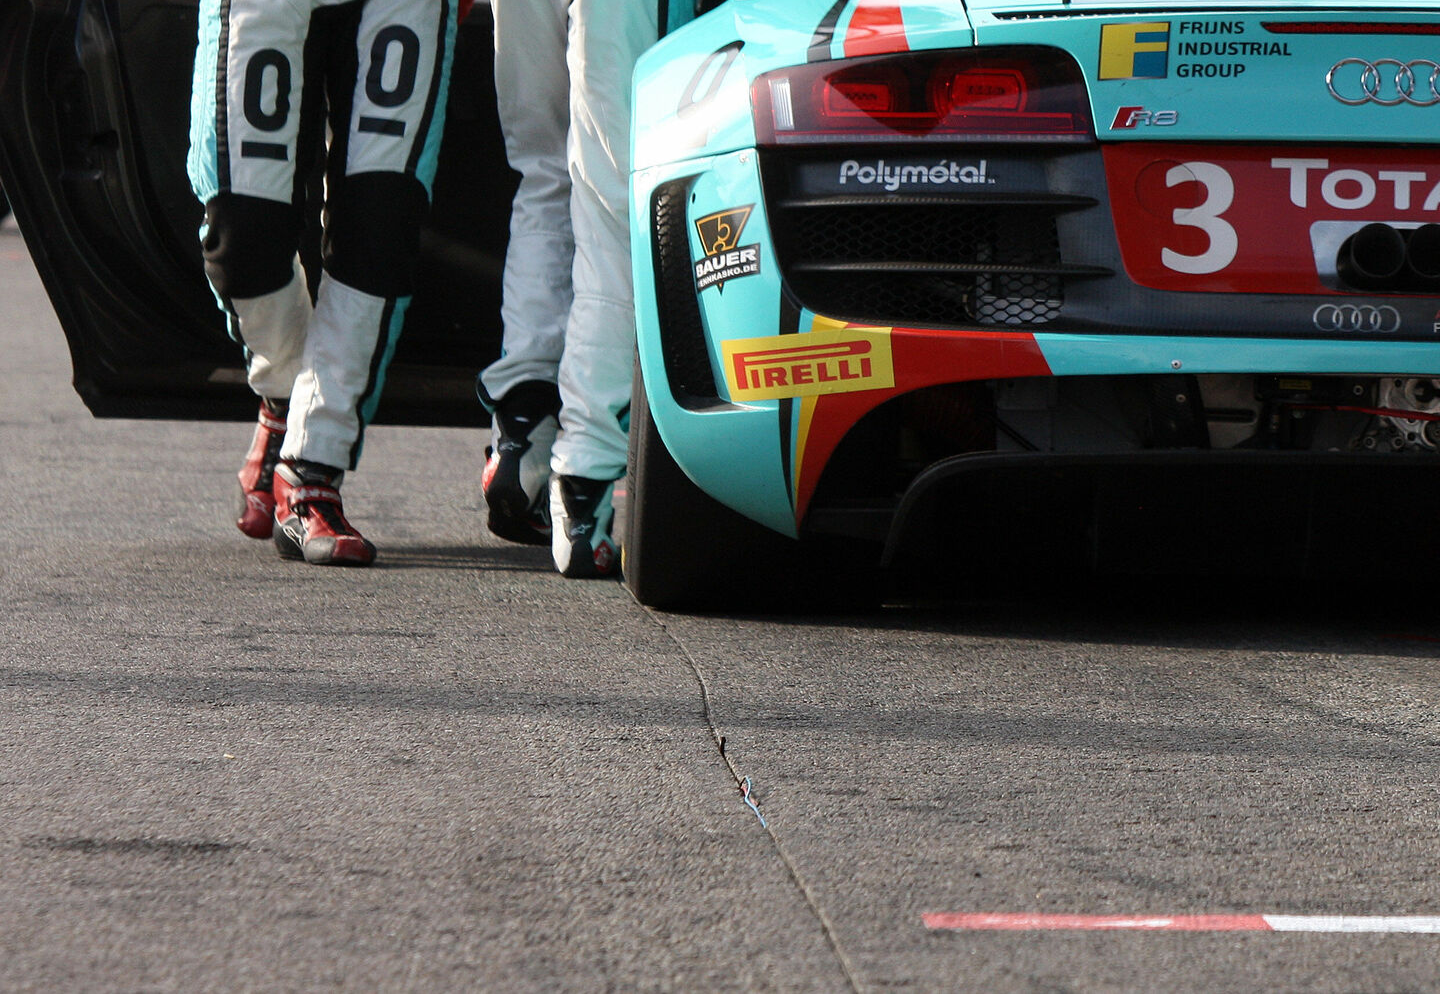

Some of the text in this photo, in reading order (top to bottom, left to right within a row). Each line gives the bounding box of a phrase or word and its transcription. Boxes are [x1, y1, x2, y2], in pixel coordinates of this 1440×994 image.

[1178, 21, 1245, 35] FRIJNS
[1177, 42, 1292, 57] INDUSTRIAL
[1176, 63, 1246, 78] GROUP
[839, 159, 987, 192] Polymétal
[1161, 160, 1238, 275] 3
[695, 248, 757, 279] BAUER
[732, 340, 872, 392] PIRELLI
